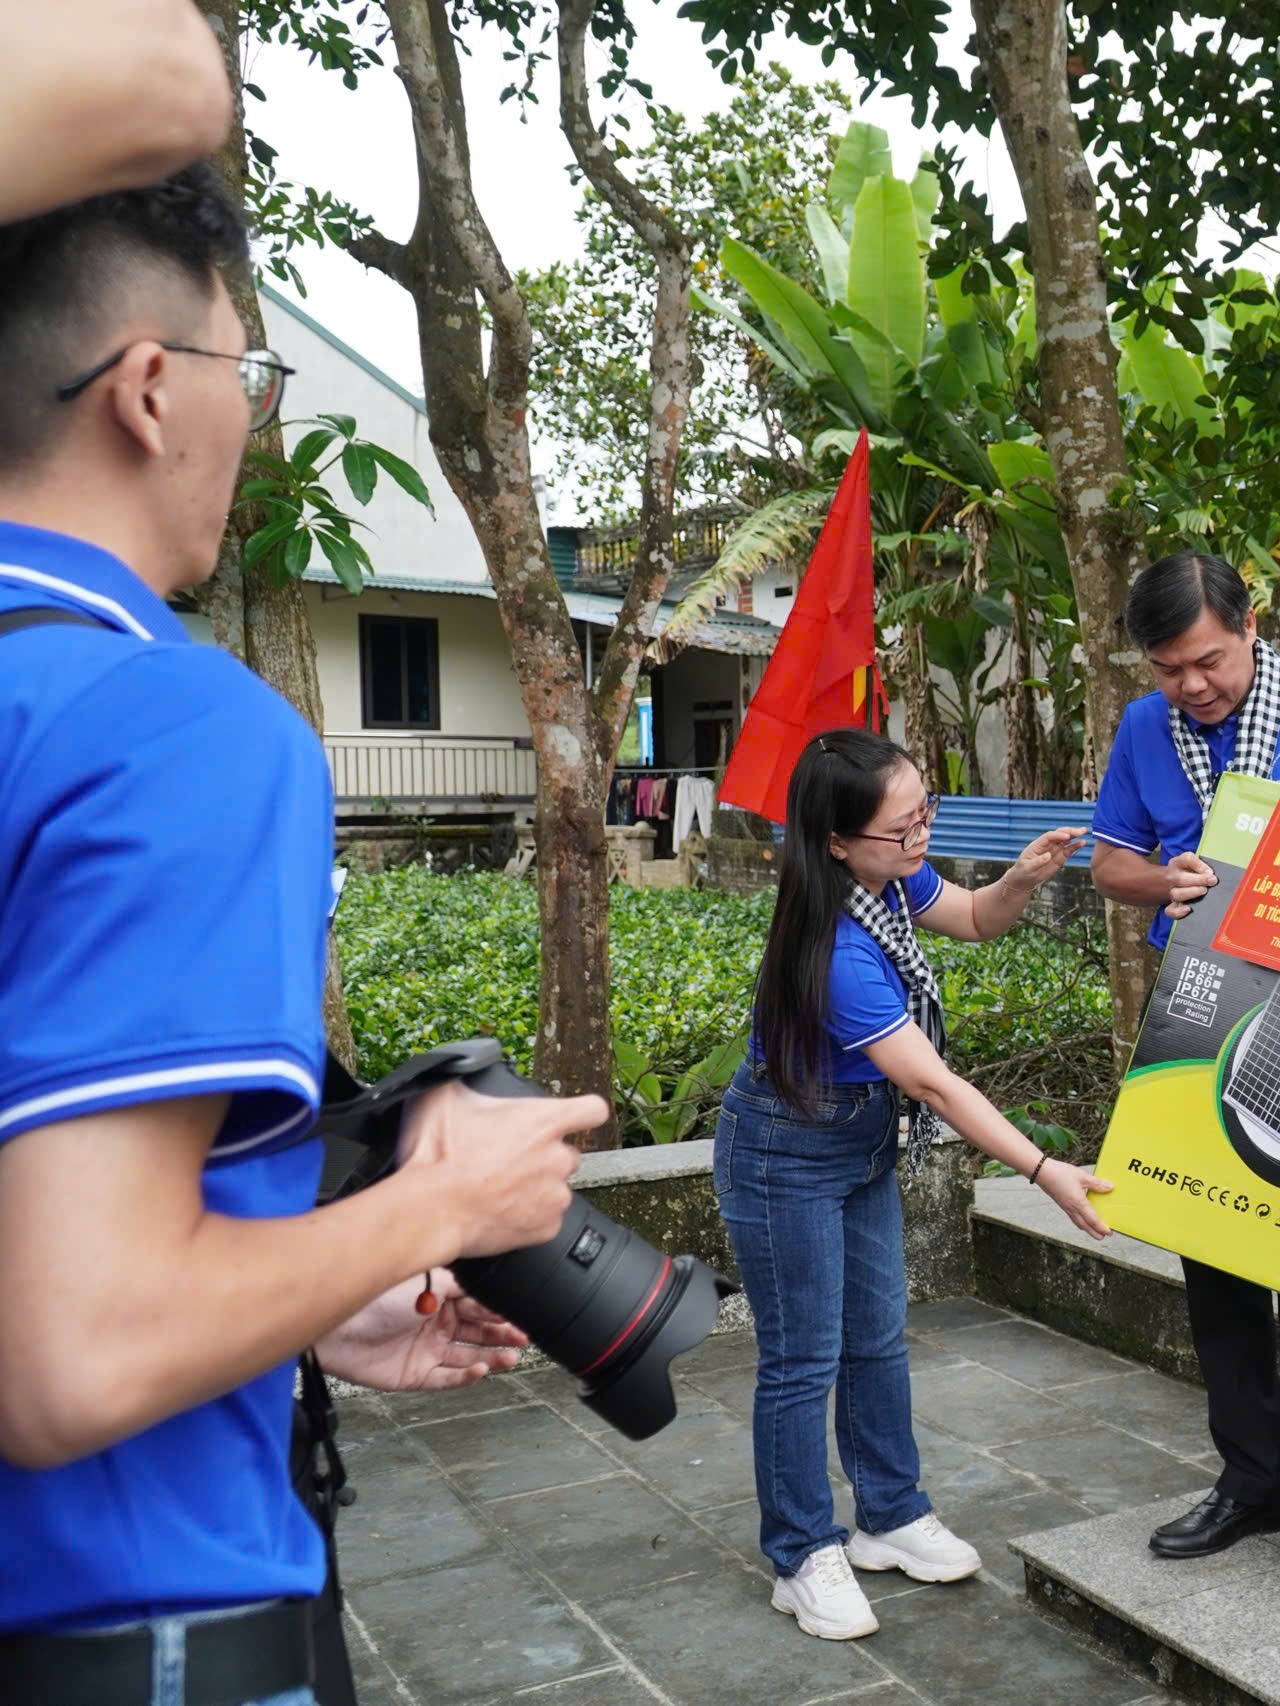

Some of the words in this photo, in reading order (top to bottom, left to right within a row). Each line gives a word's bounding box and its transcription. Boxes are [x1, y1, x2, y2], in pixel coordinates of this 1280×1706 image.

[1253, 874, 1273, 894] LẮP
[1254, 903, 1268, 917] DI
[1184, 956, 1217, 976] IP65
[1180, 968, 1213, 988] IP66
[1176, 980, 1209, 1000] IP67
[1175, 997, 1211, 1013] protection
[1185, 1008, 1209, 1022] Rating
[1128, 1158, 1179, 1186] RoHS
